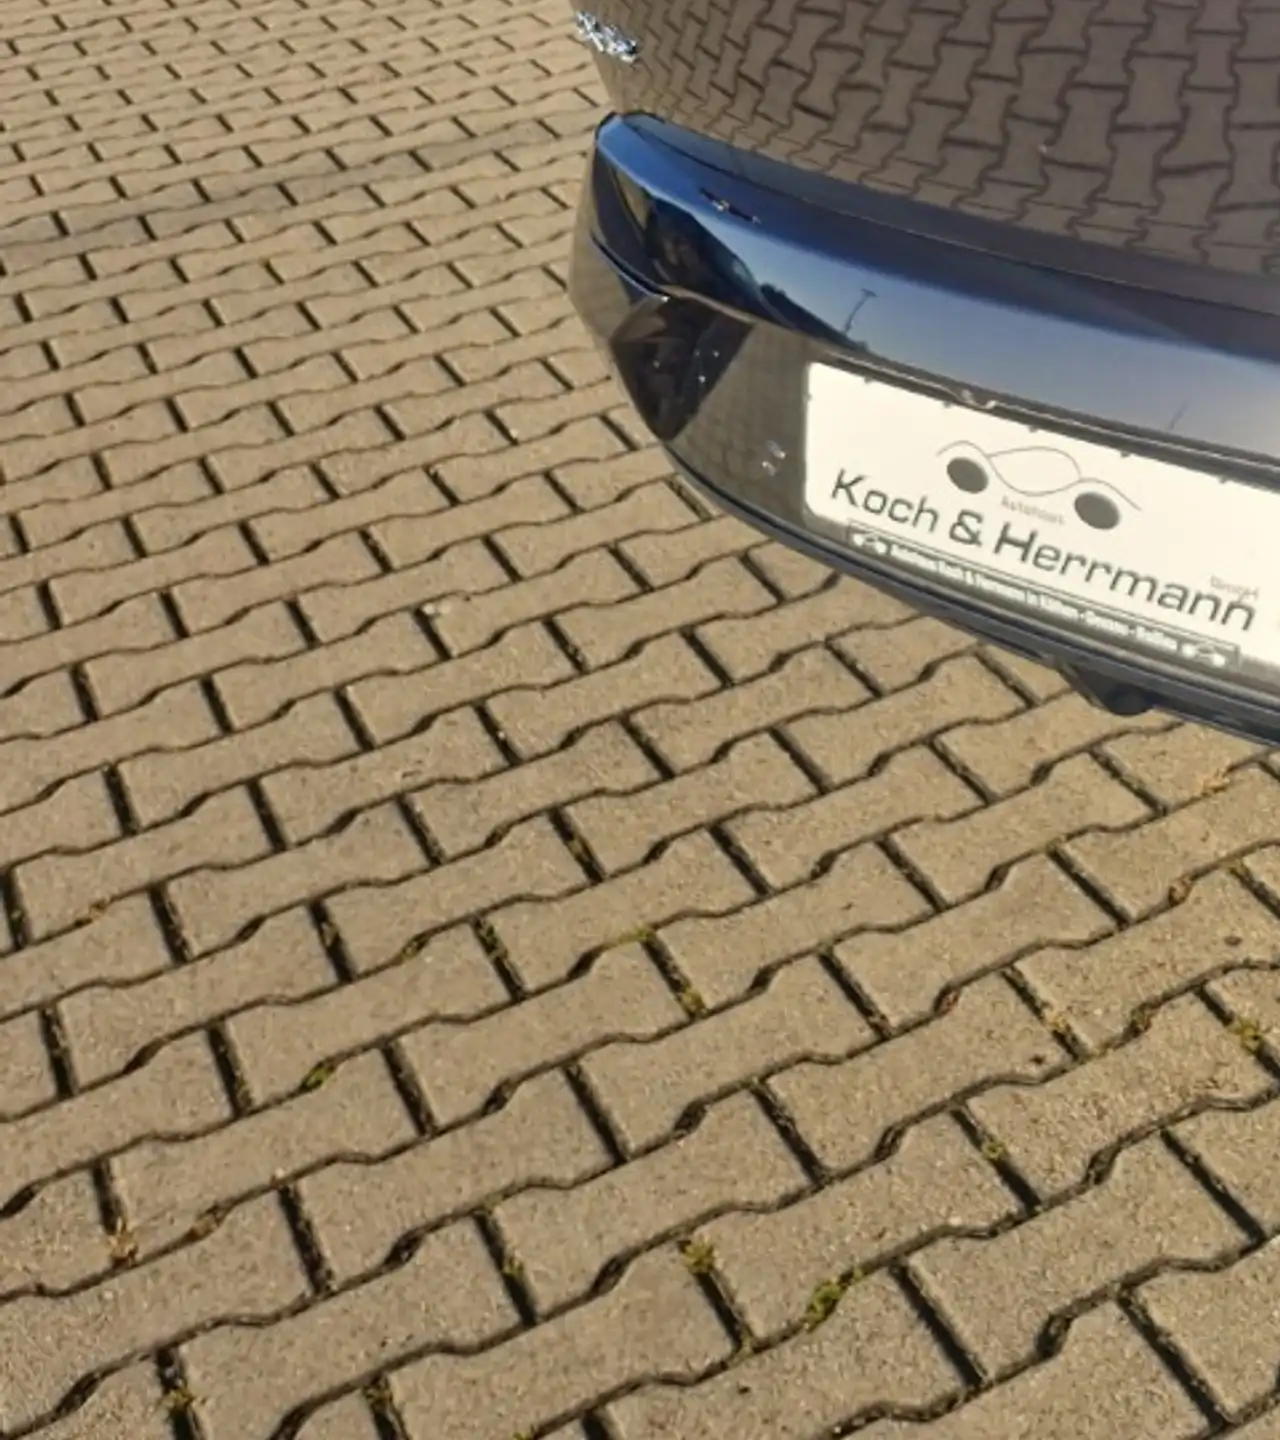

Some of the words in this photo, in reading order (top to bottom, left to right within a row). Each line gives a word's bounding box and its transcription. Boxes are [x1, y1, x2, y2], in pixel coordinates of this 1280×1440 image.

[830, 468, 939, 534] Koch
[949, 508, 983, 546] &
[993, 522, 1257, 631] Herrmann
